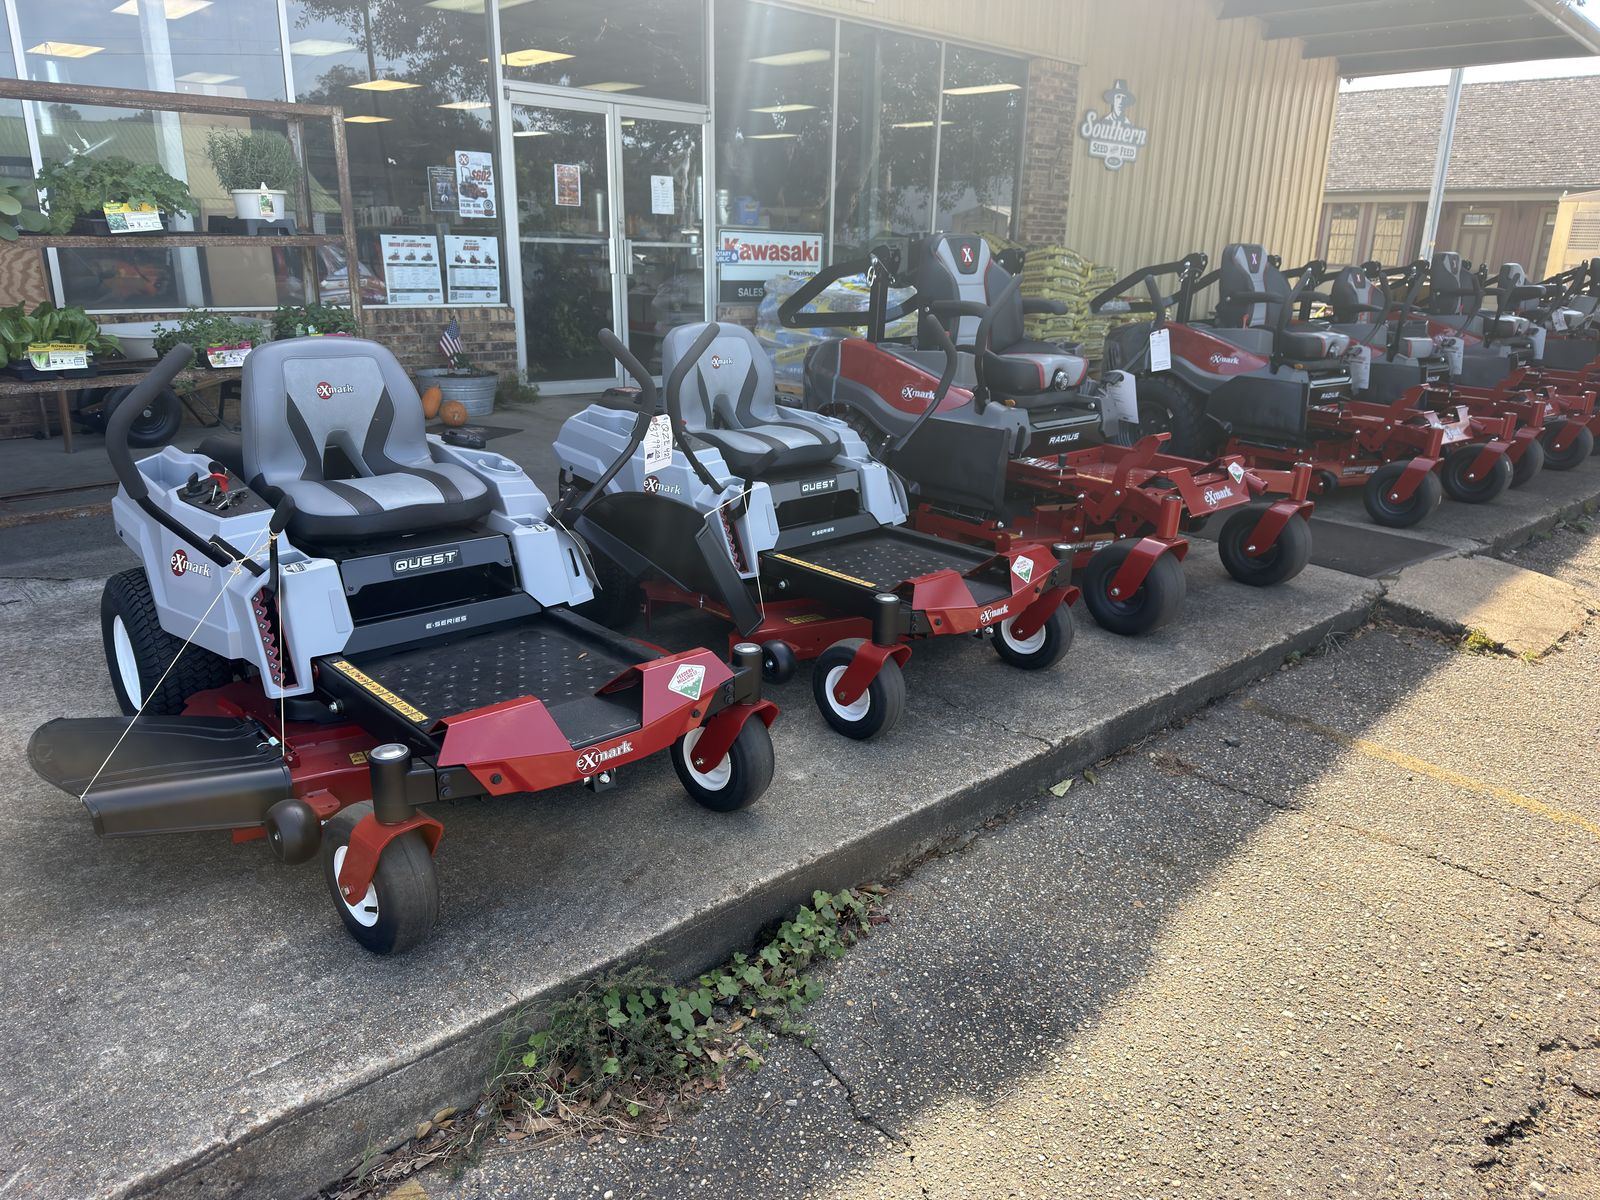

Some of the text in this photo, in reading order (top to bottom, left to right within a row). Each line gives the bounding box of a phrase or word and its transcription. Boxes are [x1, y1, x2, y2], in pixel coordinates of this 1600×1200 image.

[1081, 111, 1147, 145] Southern
[1092, 143, 1109, 154] SEED
[1120, 146, 1135, 158] FEED
[724, 238, 819, 262] Kawasaki
[738, 287, 764, 297] SALES
[1049, 432, 1080, 445] RADIUS
[802, 480, 836, 492] QUEST
[395, 550, 459, 572] QUEST
[425, 615, 468, 630] E-SERIES
